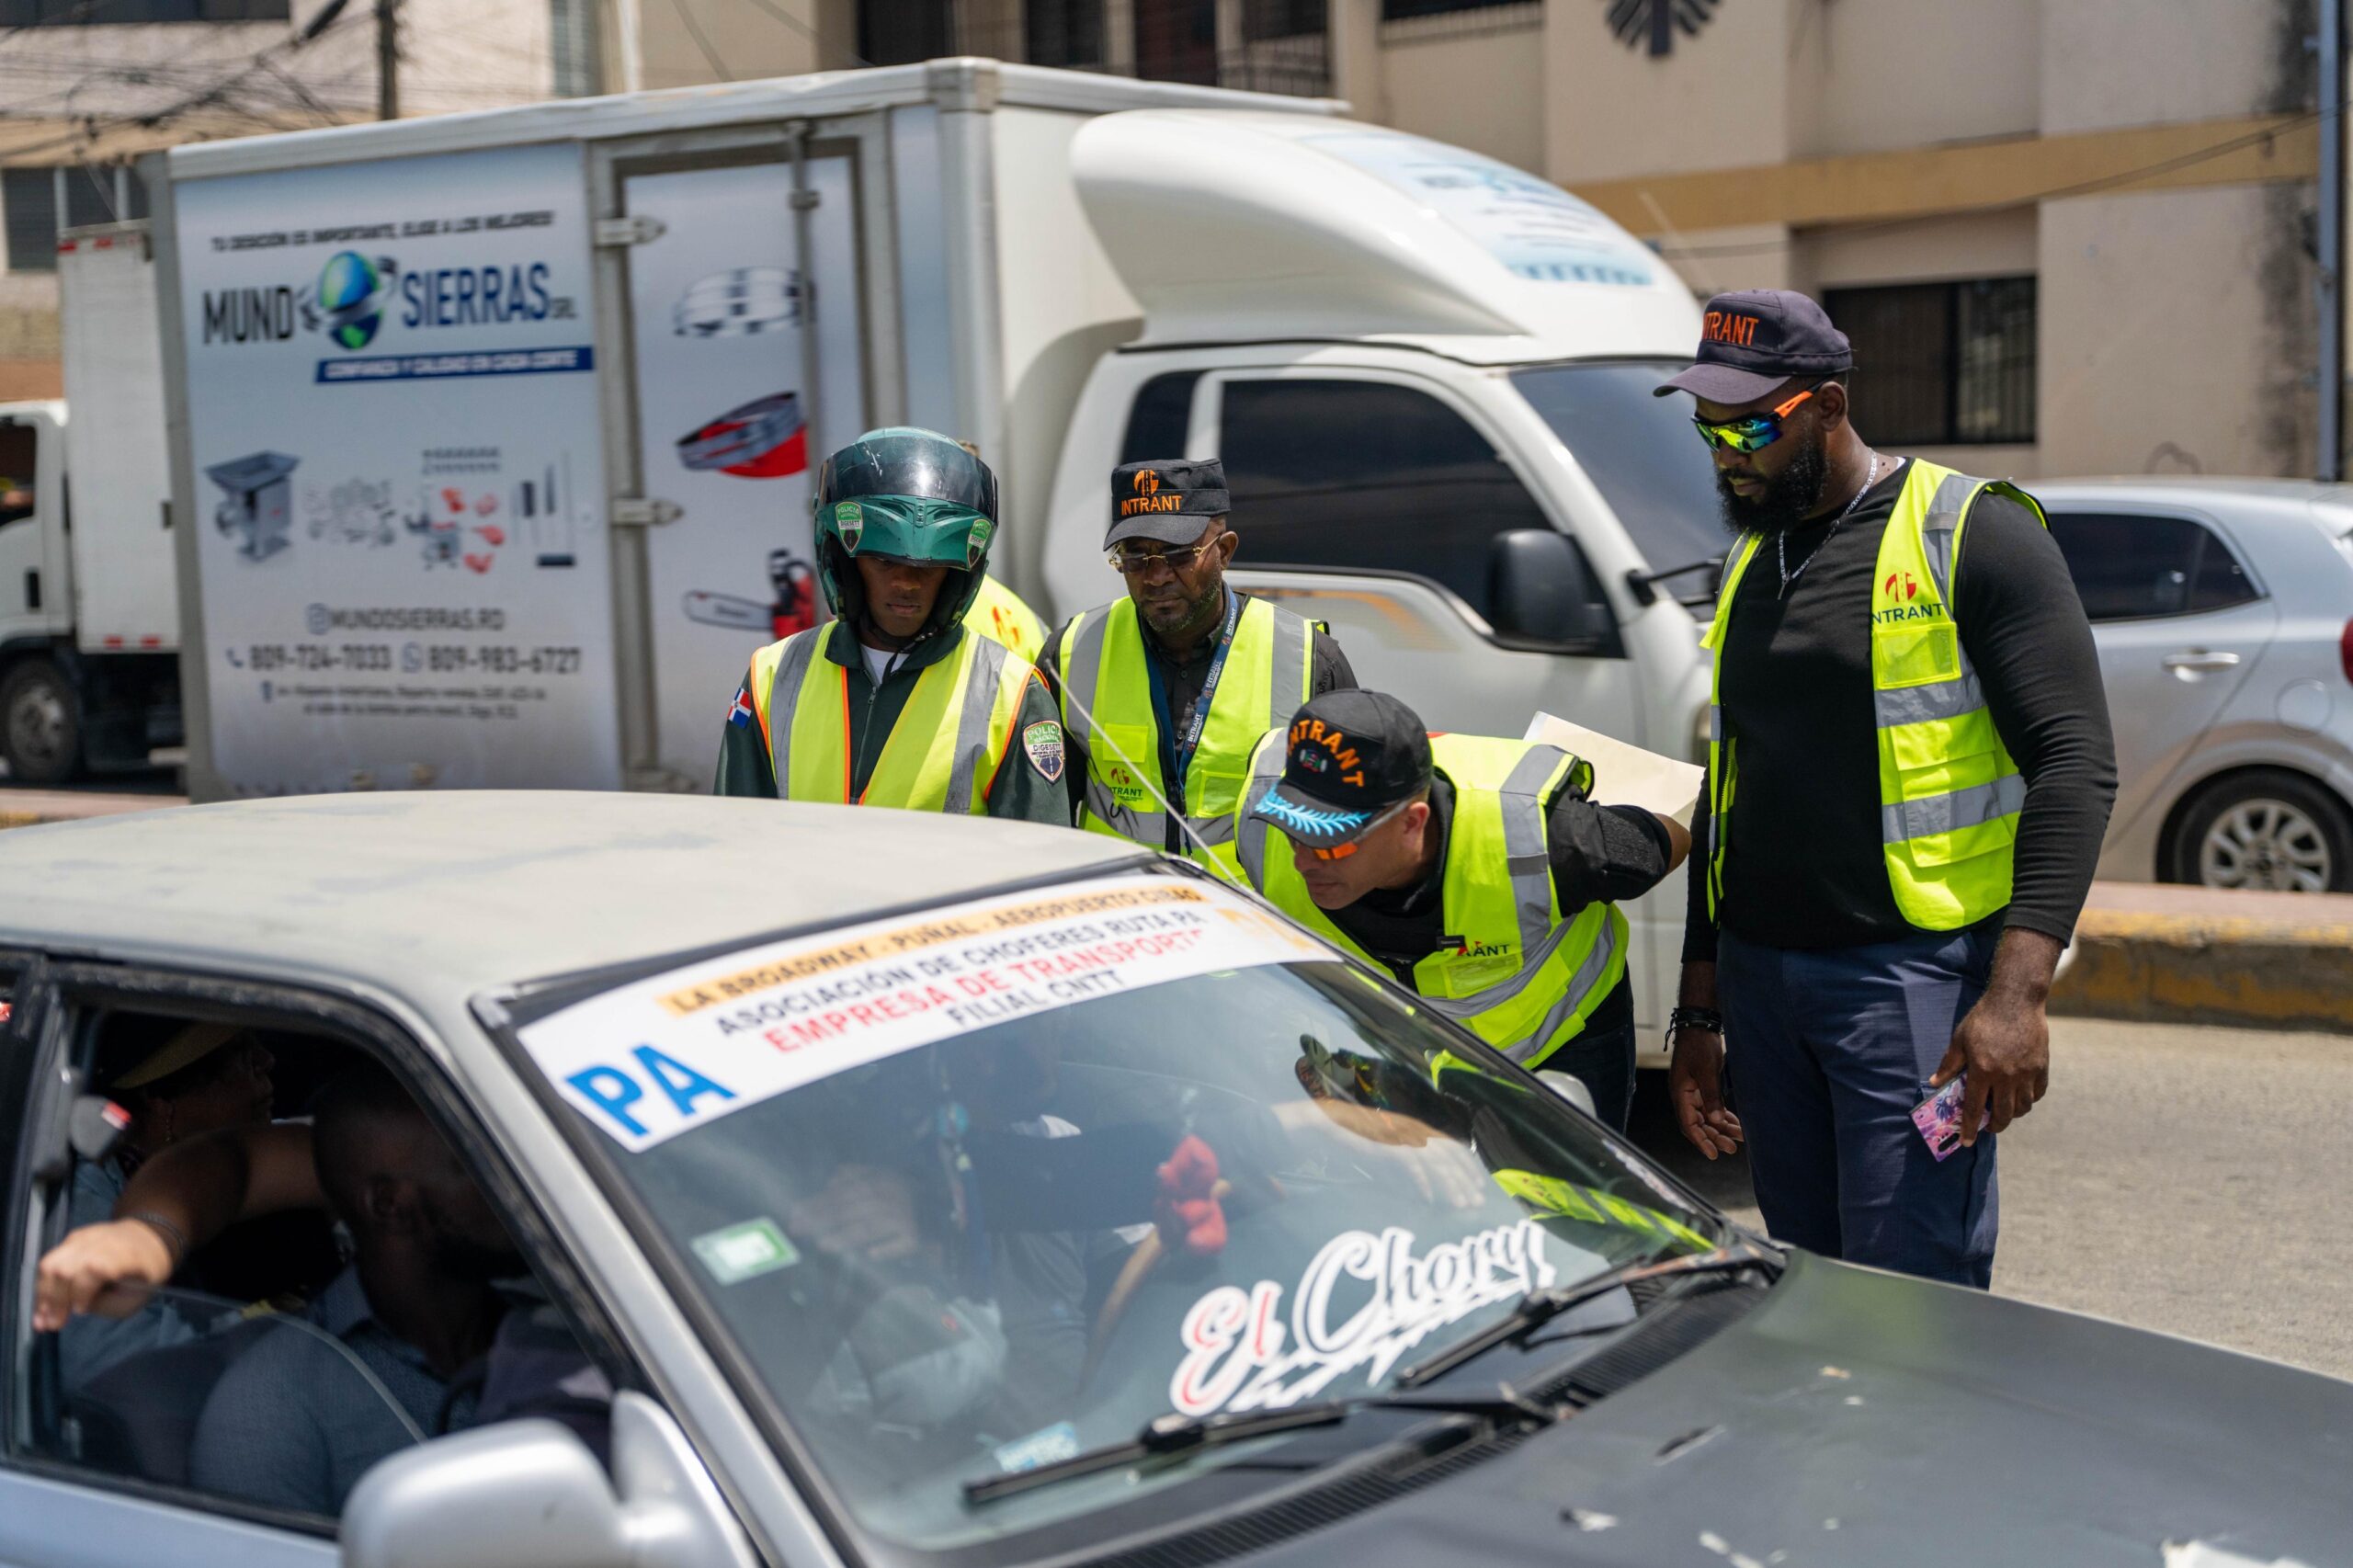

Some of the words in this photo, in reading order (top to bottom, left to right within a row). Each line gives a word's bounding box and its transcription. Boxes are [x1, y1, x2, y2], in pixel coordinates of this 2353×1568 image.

[402, 263, 551, 328] SIERRAS
[1188, 713, 1201, 743] INTRANT
[671, 989, 718, 1014] LA
[718, 944, 873, 997] BROADWAY
[716, 967, 916, 1037] ASOCIACIÓN
[916, 955, 962, 978] DE
[962, 925, 1105, 966] CHOFERES
[1104, 914, 1173, 936] RUTA
[947, 988, 1048, 1027] FILIAL
[1049, 970, 1125, 999] CNTT
[763, 987, 956, 1055] EMPRESA
[955, 970, 1012, 997] DE
[564, 1044, 737, 1137] PA
